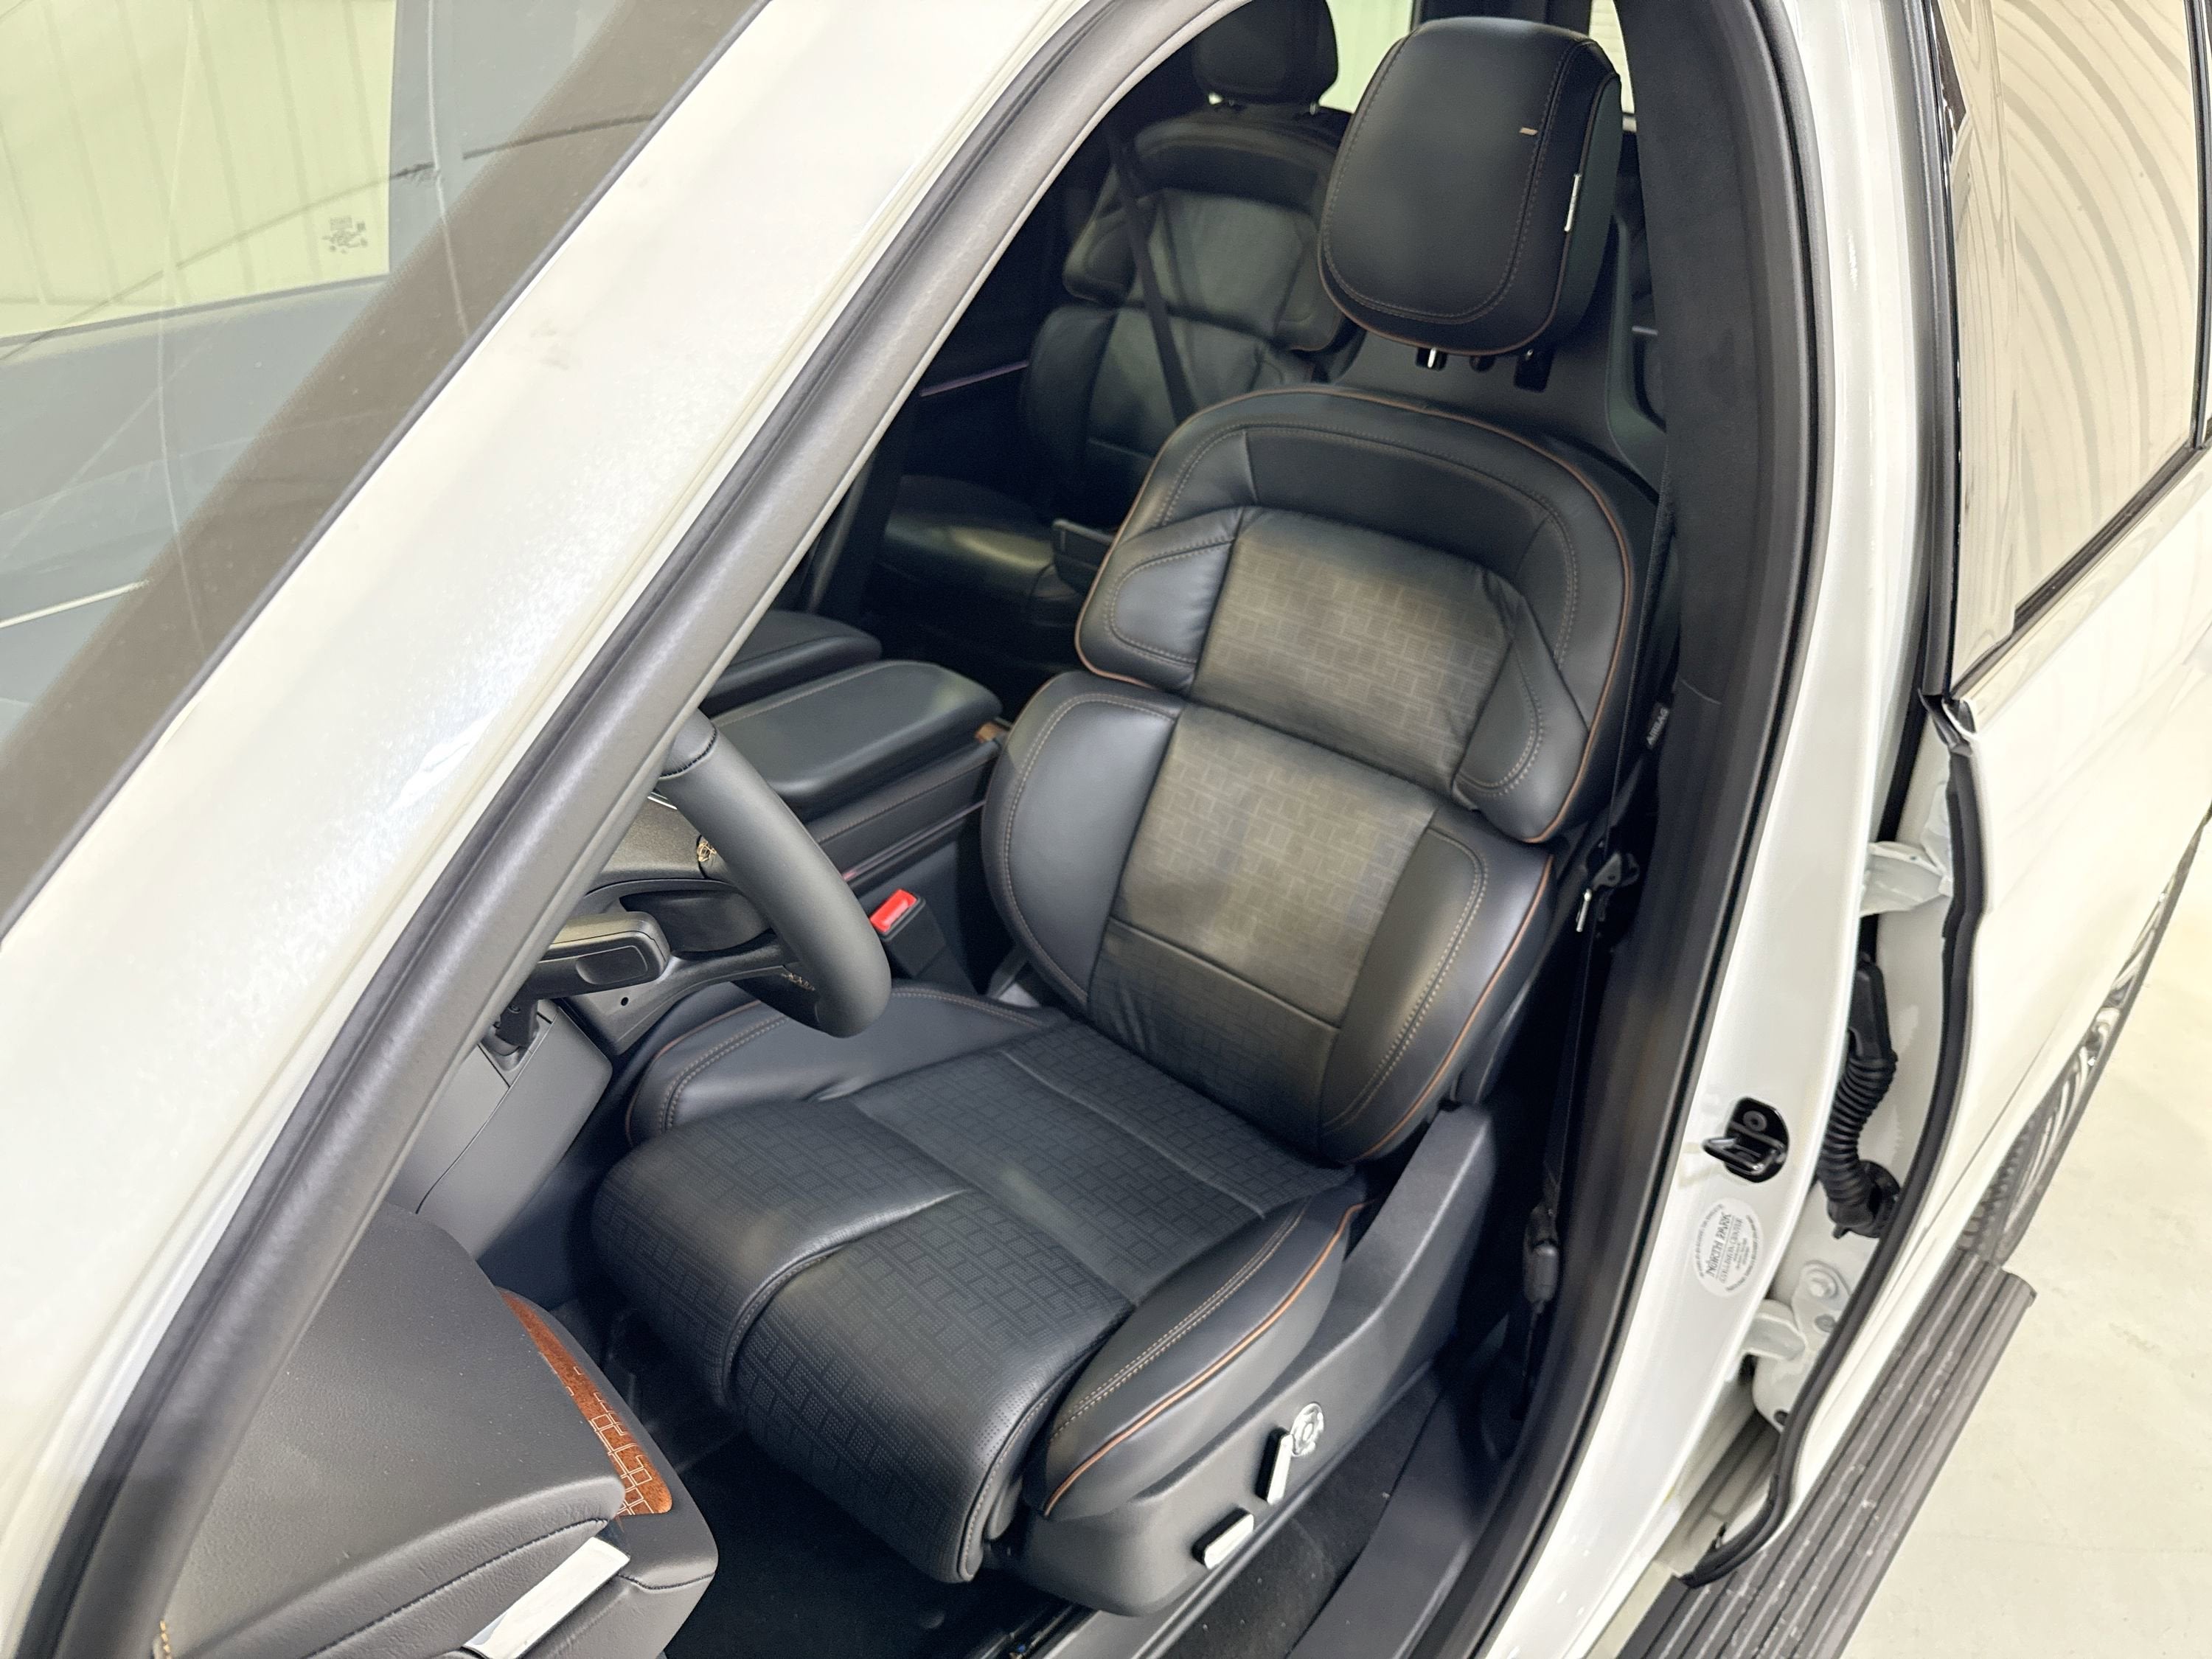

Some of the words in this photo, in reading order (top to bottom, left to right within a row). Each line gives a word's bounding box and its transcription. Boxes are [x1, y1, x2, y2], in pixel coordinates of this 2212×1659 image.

[1646, 706, 1670, 746] AIRBAG
[1705, 1239, 1724, 1278] NORTH
[1715, 1211, 1731, 1240] PARK
